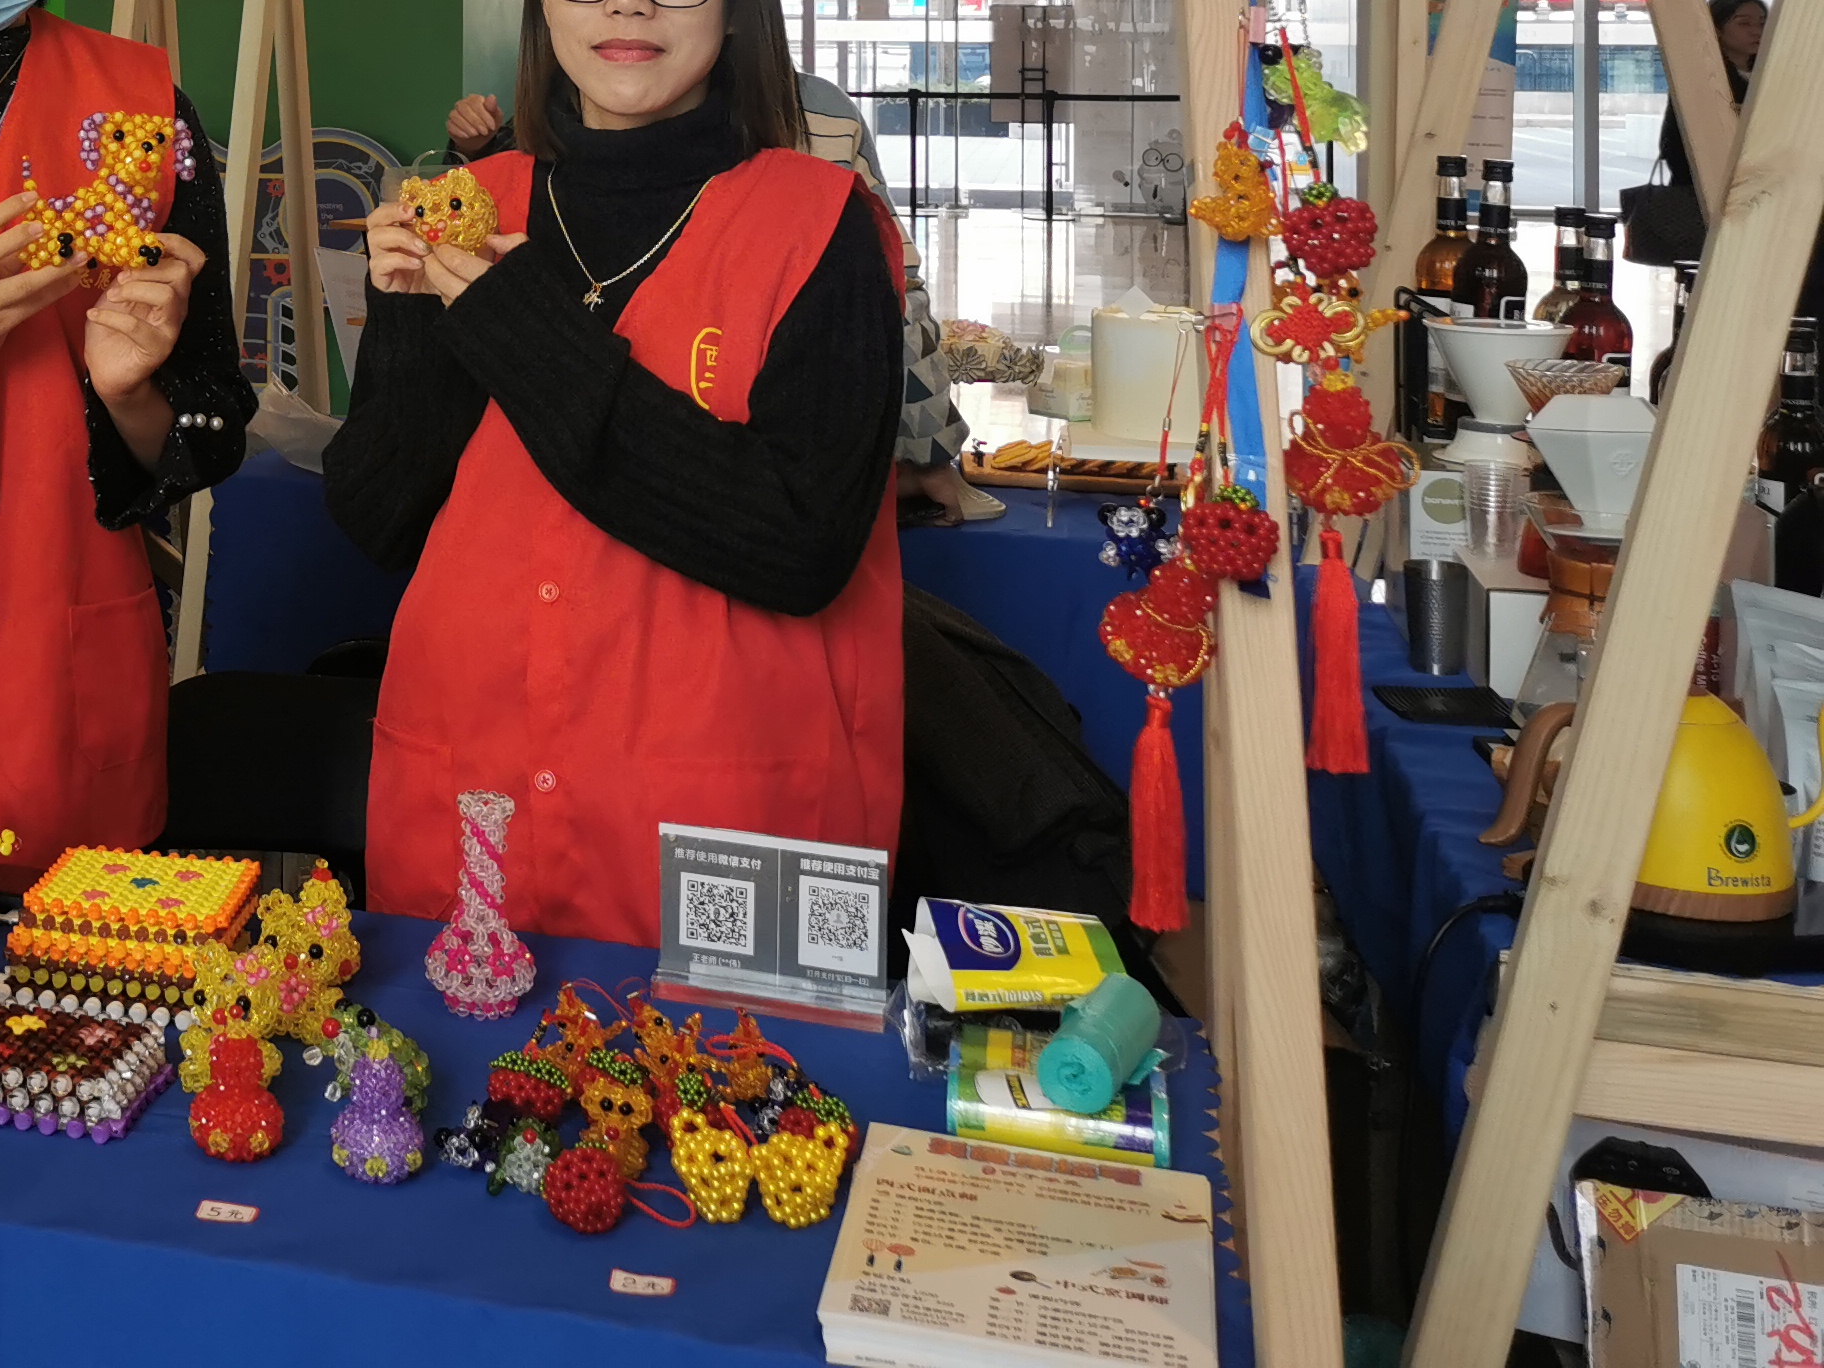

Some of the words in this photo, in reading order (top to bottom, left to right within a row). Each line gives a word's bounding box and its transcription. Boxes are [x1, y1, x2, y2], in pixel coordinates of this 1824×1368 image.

[674, 846, 763, 871] 推荐使用微信支付
[799, 857, 880, 881] 推荐使用支付宝
[1706, 866, 1772, 888] Brewista
